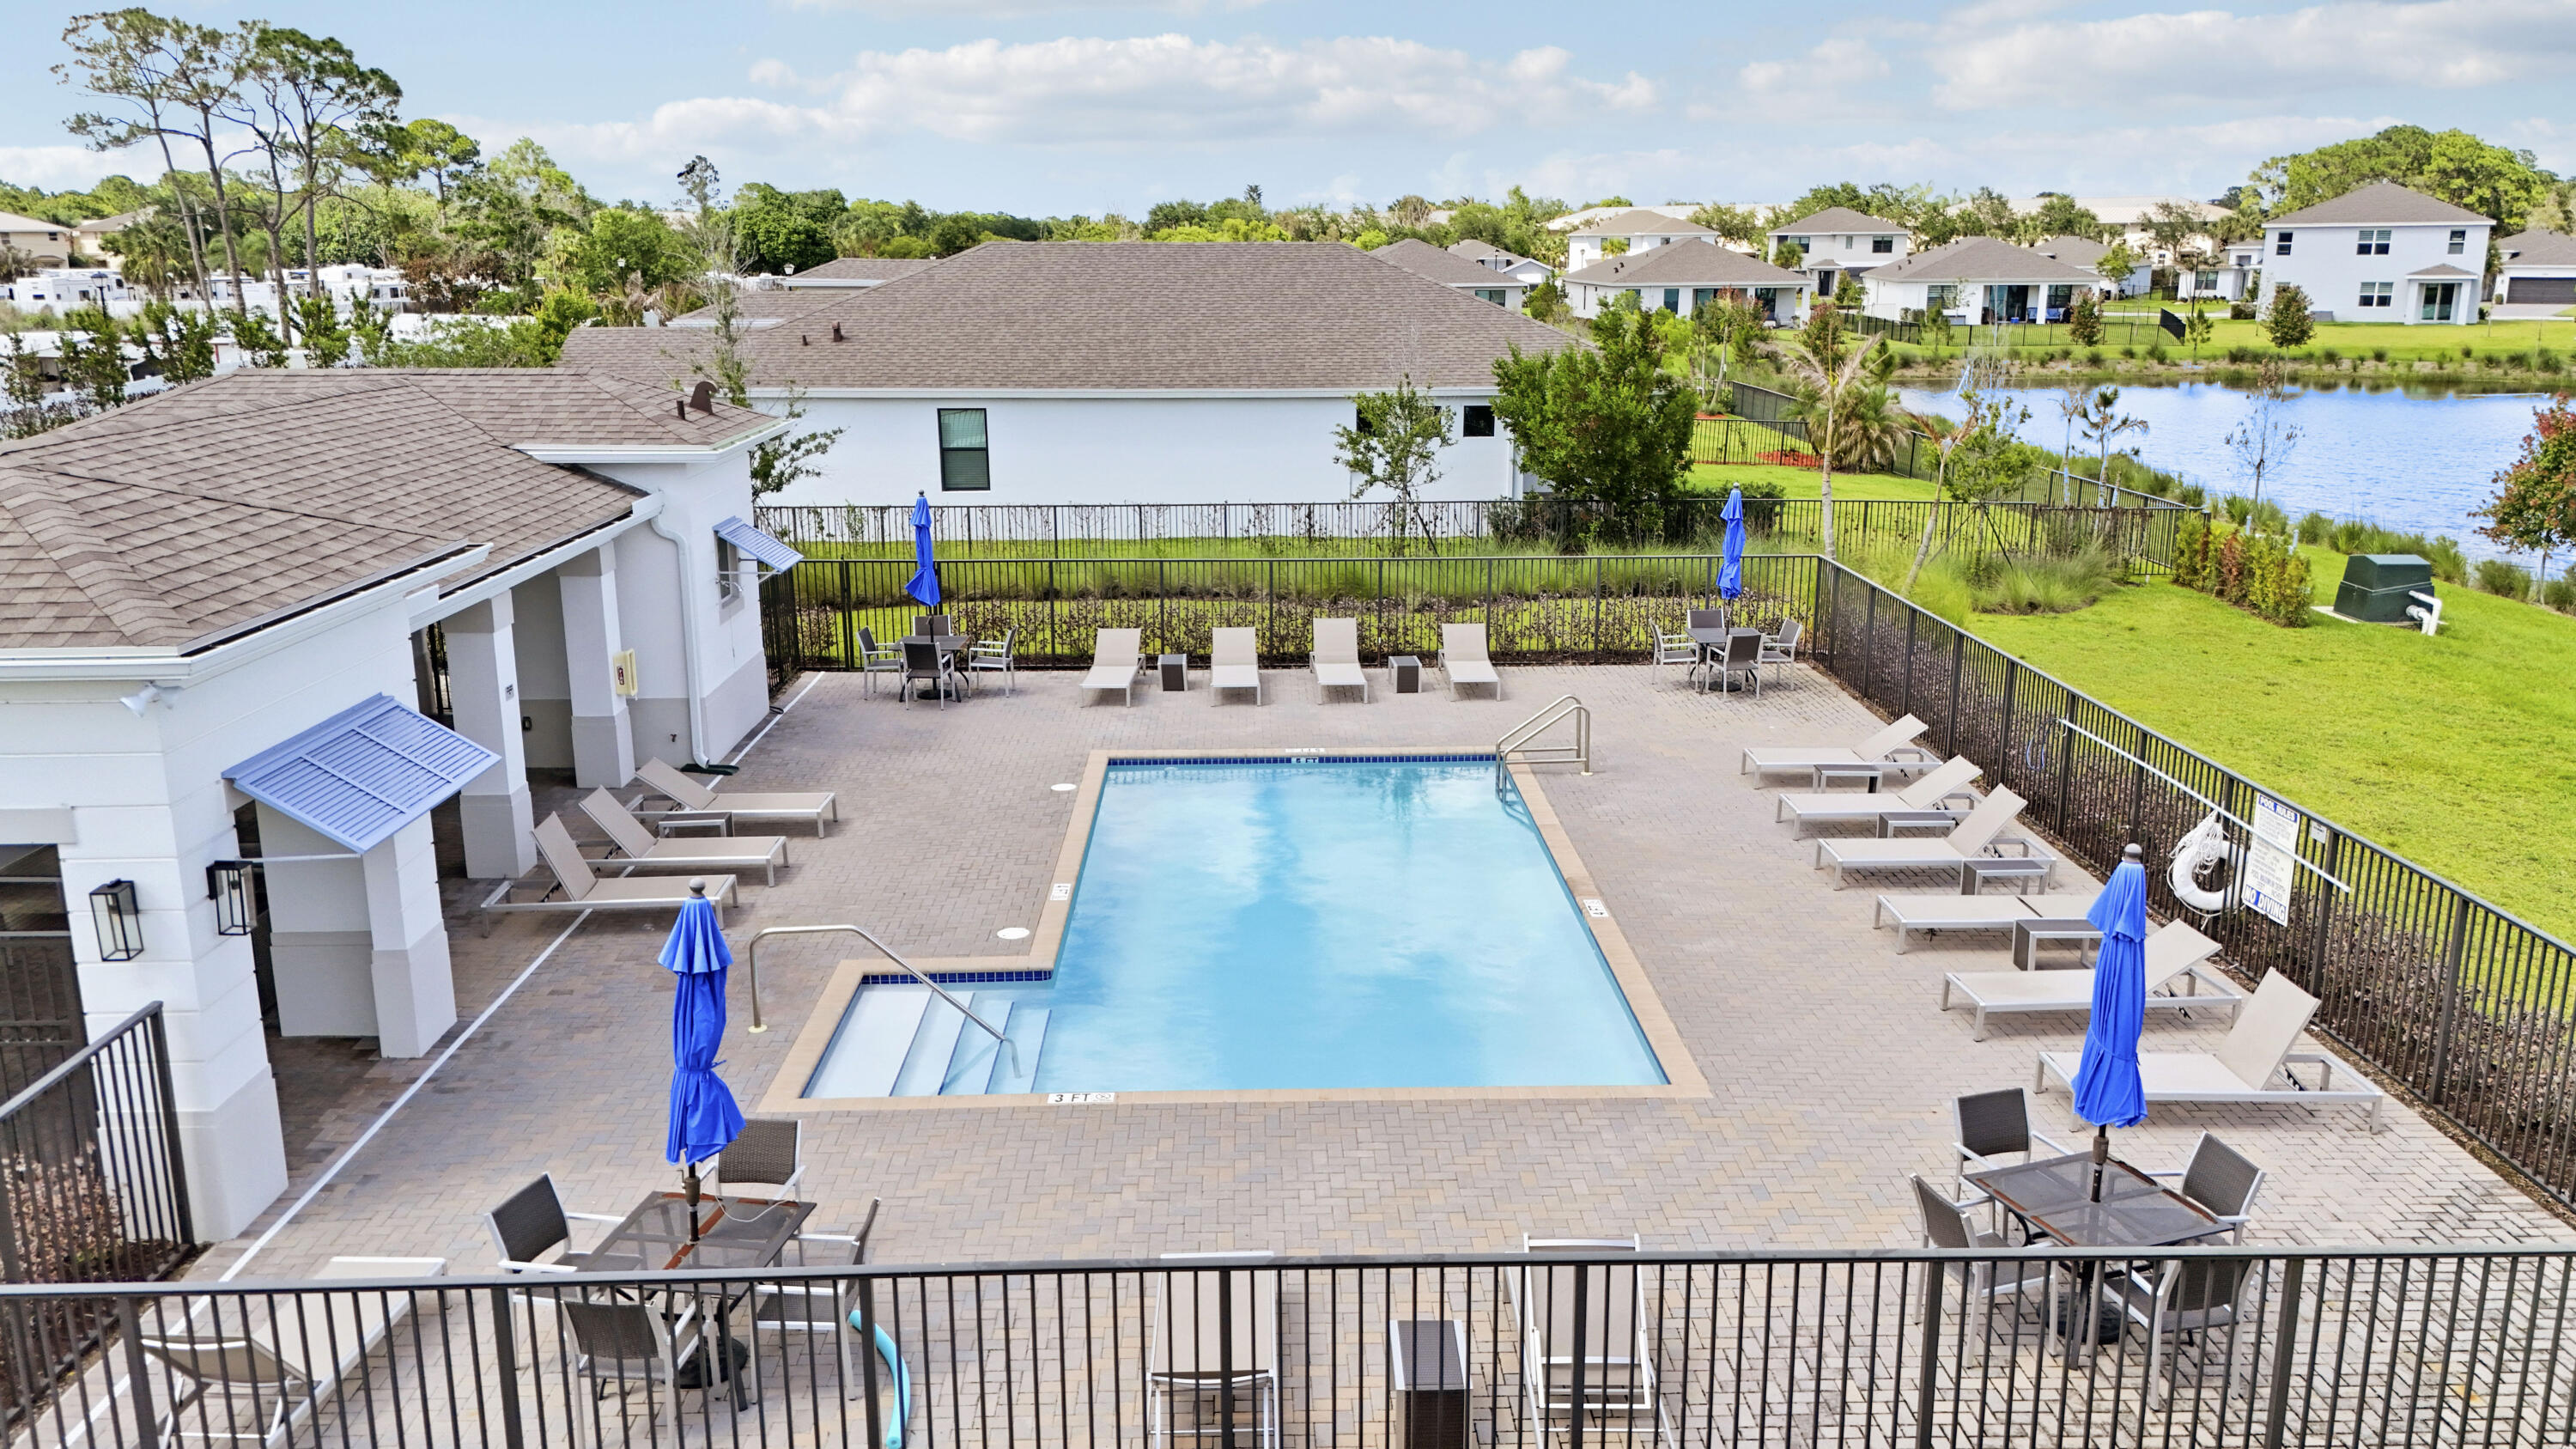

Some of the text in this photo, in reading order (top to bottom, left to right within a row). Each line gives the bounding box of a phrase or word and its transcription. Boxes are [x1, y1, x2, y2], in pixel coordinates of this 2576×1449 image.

[2259, 795, 2296, 822] POOL RULES
[2244, 886, 2286, 922] NO DIVING
[1054, 1093, 1091, 1103] 3 FT
